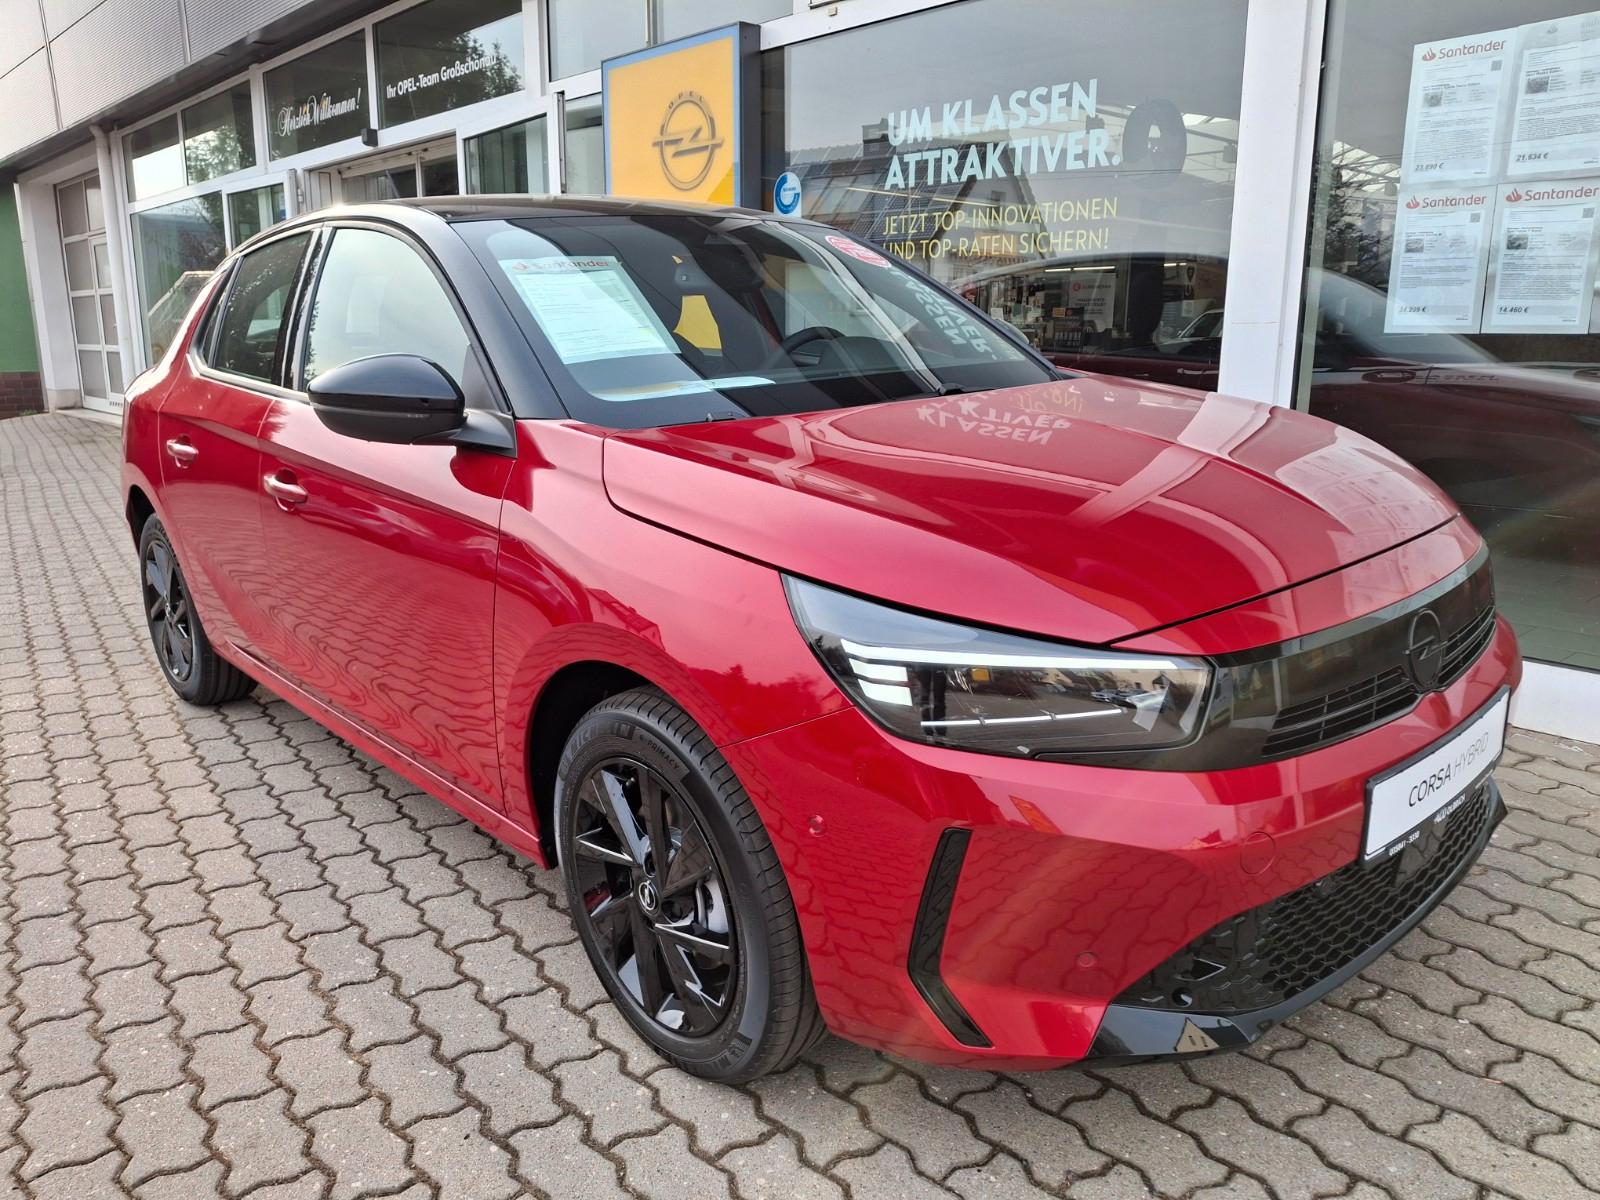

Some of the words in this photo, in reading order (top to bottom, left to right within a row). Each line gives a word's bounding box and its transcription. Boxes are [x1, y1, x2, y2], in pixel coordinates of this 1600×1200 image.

[1438, 40, 1506, 59] Santander
[386, 84, 397, 99] Ihr
[397, 73, 440, 95] OPEL-Team
[440, 55, 496, 81] Großschönau
[278, 105, 310, 136] Herzlich
[307, 87, 361, 126] Willkommen!
[667, 90, 703, 110] OPEL
[887, 106, 933, 146] UM
[942, 78, 1098, 138] KLASSEN
[884, 128, 1121, 190] ATTRAKTIVER.
[1422, 194, 1487, 209] Santander
[1525, 186, 1599, 201] Santander
[883, 213, 928, 235] JETZT
[932, 197, 1118, 231] TOP-INNOVATIONEN
[920, 234, 1014, 260] TOP-RATEN
[1020, 227, 1109, 254] SICHERN!
[1409, 763, 1451, 808] CORSA
[1454, 731, 1489, 777] HYBRID
